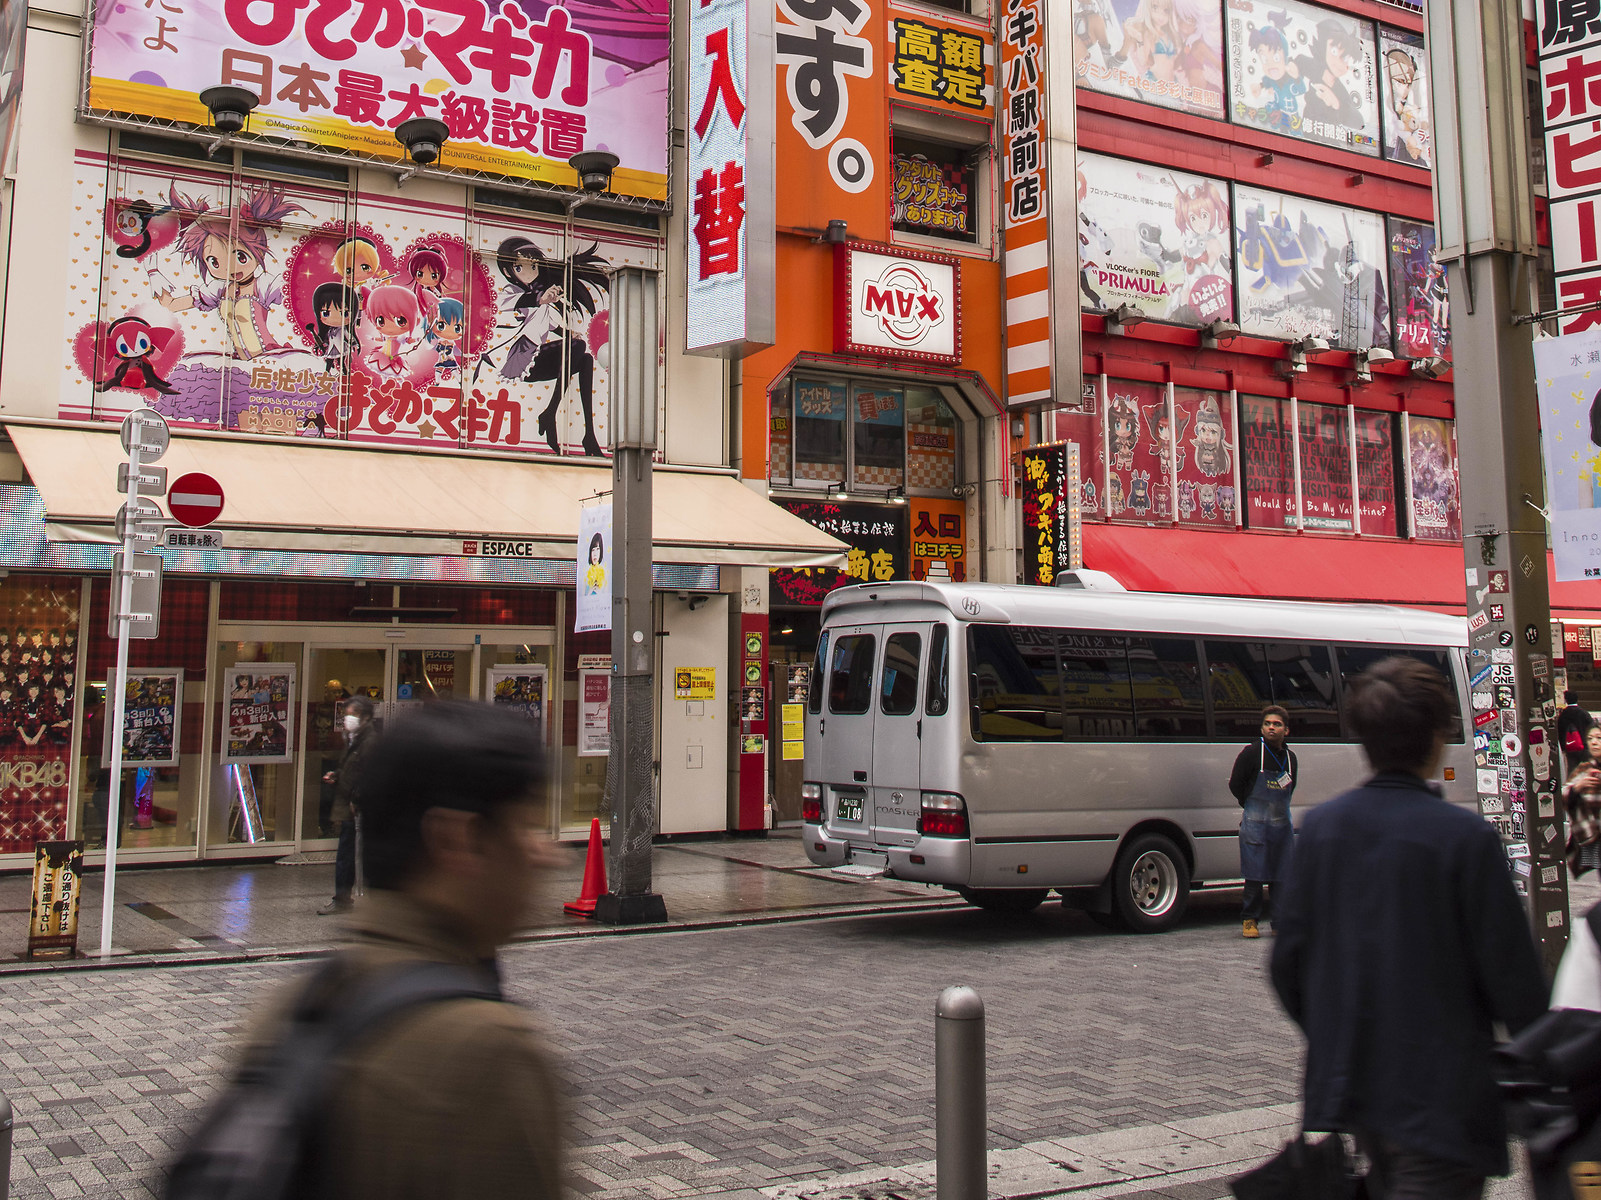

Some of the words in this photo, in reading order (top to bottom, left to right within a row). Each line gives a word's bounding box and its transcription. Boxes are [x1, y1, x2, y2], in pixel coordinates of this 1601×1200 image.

[896, 21, 982, 71] 高額
[896, 52, 985, 109] 査定
[219, 48, 589, 160] 日本最大級設置
[488, 155, 542, 172] ENTERTAINMENT
[898, 159, 942, 181] アダルト
[906, 204, 966, 231] あります!
[1191, 278, 1228, 305] いよいよ
[1396, 323, 1430, 345] アリス
[251, 358, 277, 366] SLOT
[799, 385, 832, 402] アイドル
[249, 405, 318, 419] MADOKA
[1319, 457, 1392, 478] VALETINE'S
[1254, 495, 1281, 510] Would
[1307, 500, 1319, 512] Be
[1322, 502, 1336, 517] My
[1338, 503, 1387, 517] Valntine?
[811, 518, 895, 537] から始まる伝説
[913, 511, 962, 539] 入口
[168, 533, 218, 547] 自転車を除く
[1036, 492, 1054, 584] アキバ商店
[482, 541, 533, 556] ESPACE
[913, 541, 964, 560] はコチラ
[1470, 614, 1487, 629] LUST
[1492, 676, 1515, 684] ONE
[1494, 665, 1512, 676] JS
[133, 714, 174, 728] 新台入替
[250, 710, 288, 724] 新台入替
[876, 806, 920, 817] COASTER
[39, 872, 53, 933] ご遠慮下さい
